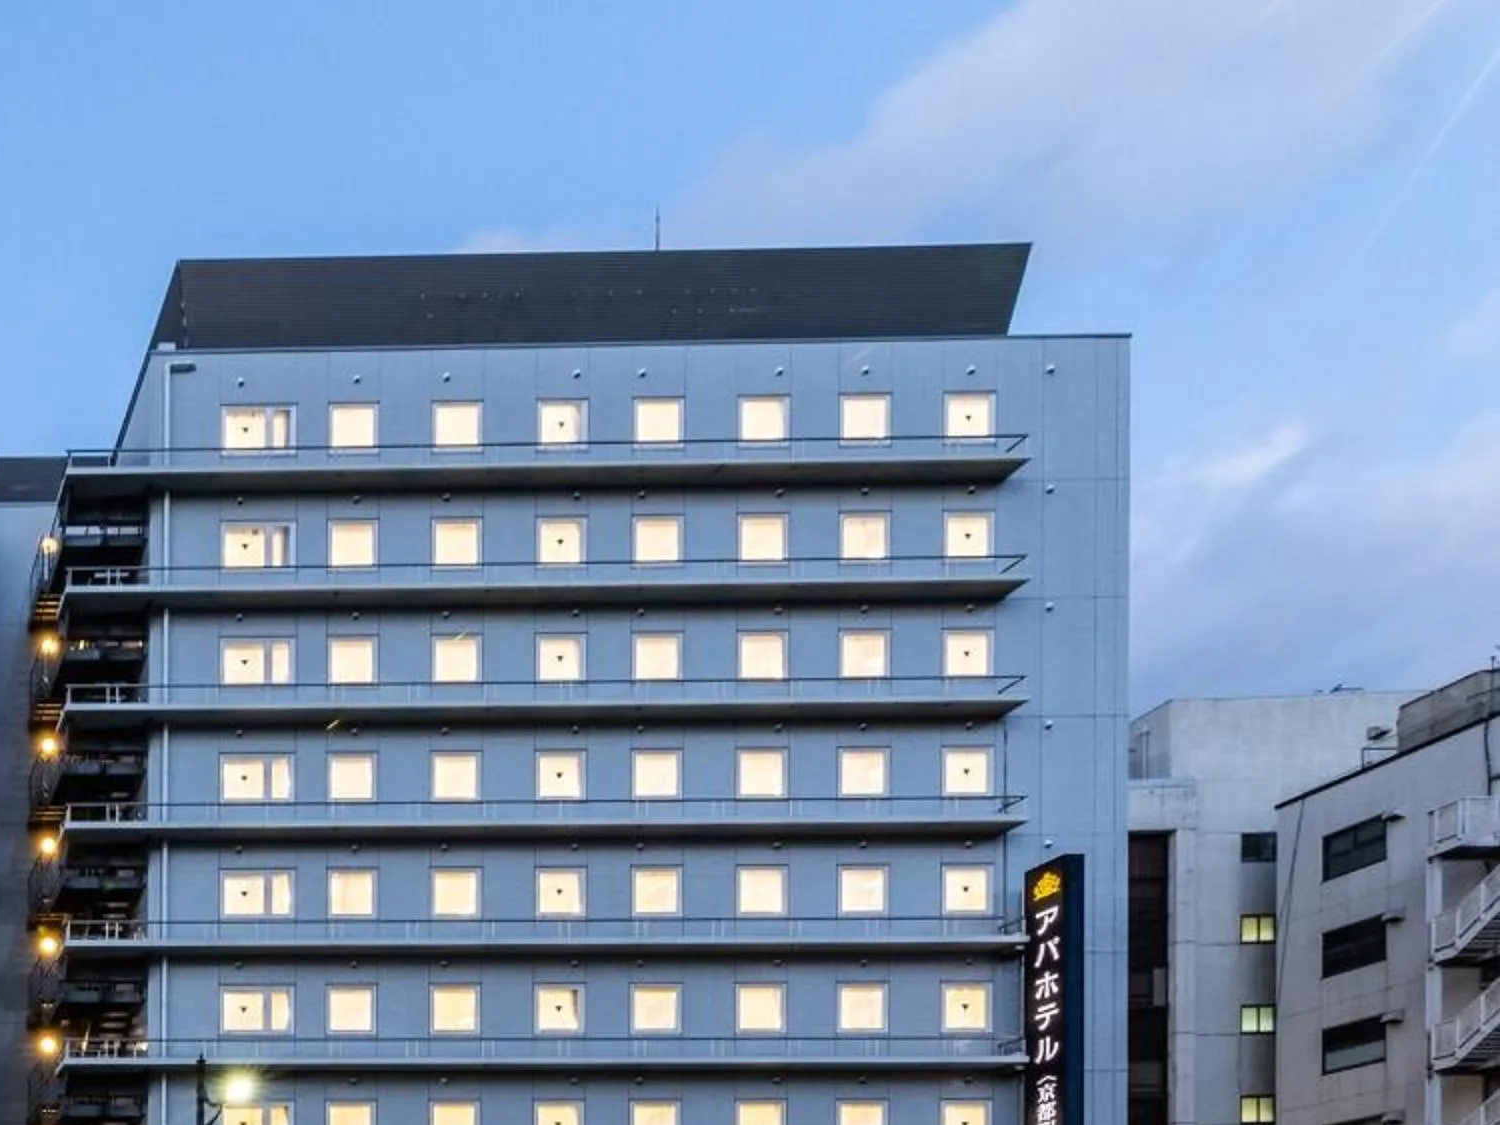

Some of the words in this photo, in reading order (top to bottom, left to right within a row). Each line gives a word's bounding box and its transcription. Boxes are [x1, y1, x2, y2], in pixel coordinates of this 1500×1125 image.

[1033, 904, 1060, 1064] アパホテル
